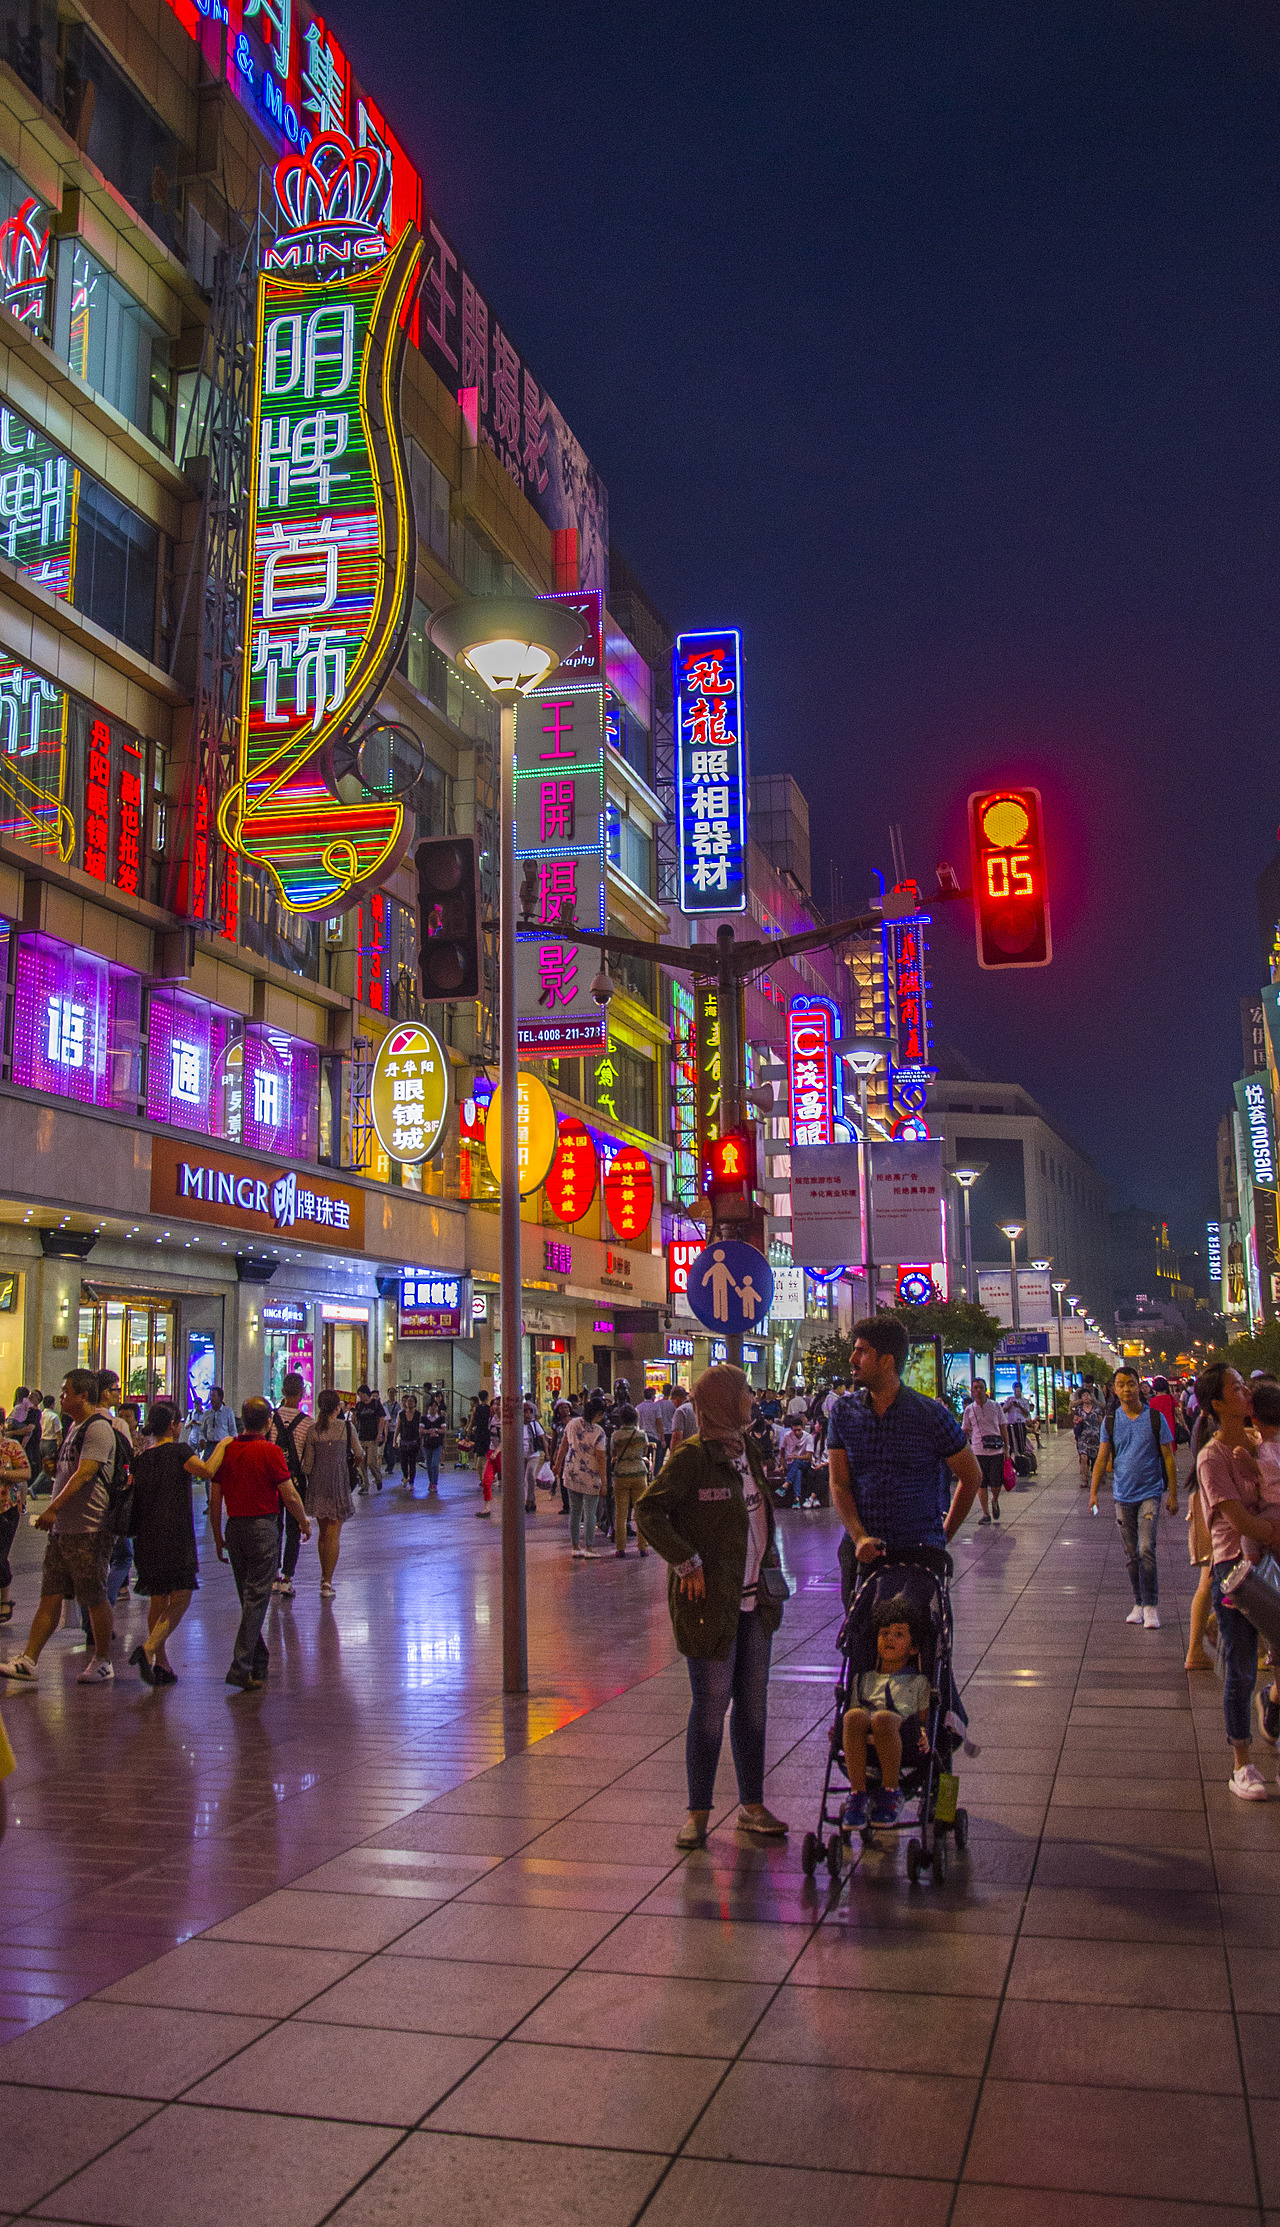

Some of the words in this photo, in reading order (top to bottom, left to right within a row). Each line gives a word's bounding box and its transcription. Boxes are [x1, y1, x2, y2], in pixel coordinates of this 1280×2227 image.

[264, 240, 385, 270] MING
[253, 303, 355, 731] 明牌首饰
[683, 648, 736, 891] 冠龍照相器材
[987, 855, 1033, 898] 05
[384, 1060, 434, 1078] 丹华阳
[392, 1077, 425, 1150] 眼镜城
[423, 1120, 440, 1133] 3F
[183, 1162, 269, 1213] MINGR
[273, 1171, 350, 1230] 明牌珠宝
[1207, 1221, 1220, 1233] 21
[1208, 1236, 1222, 1281] FOREVER
[545, 1376, 562, 1392] 39
